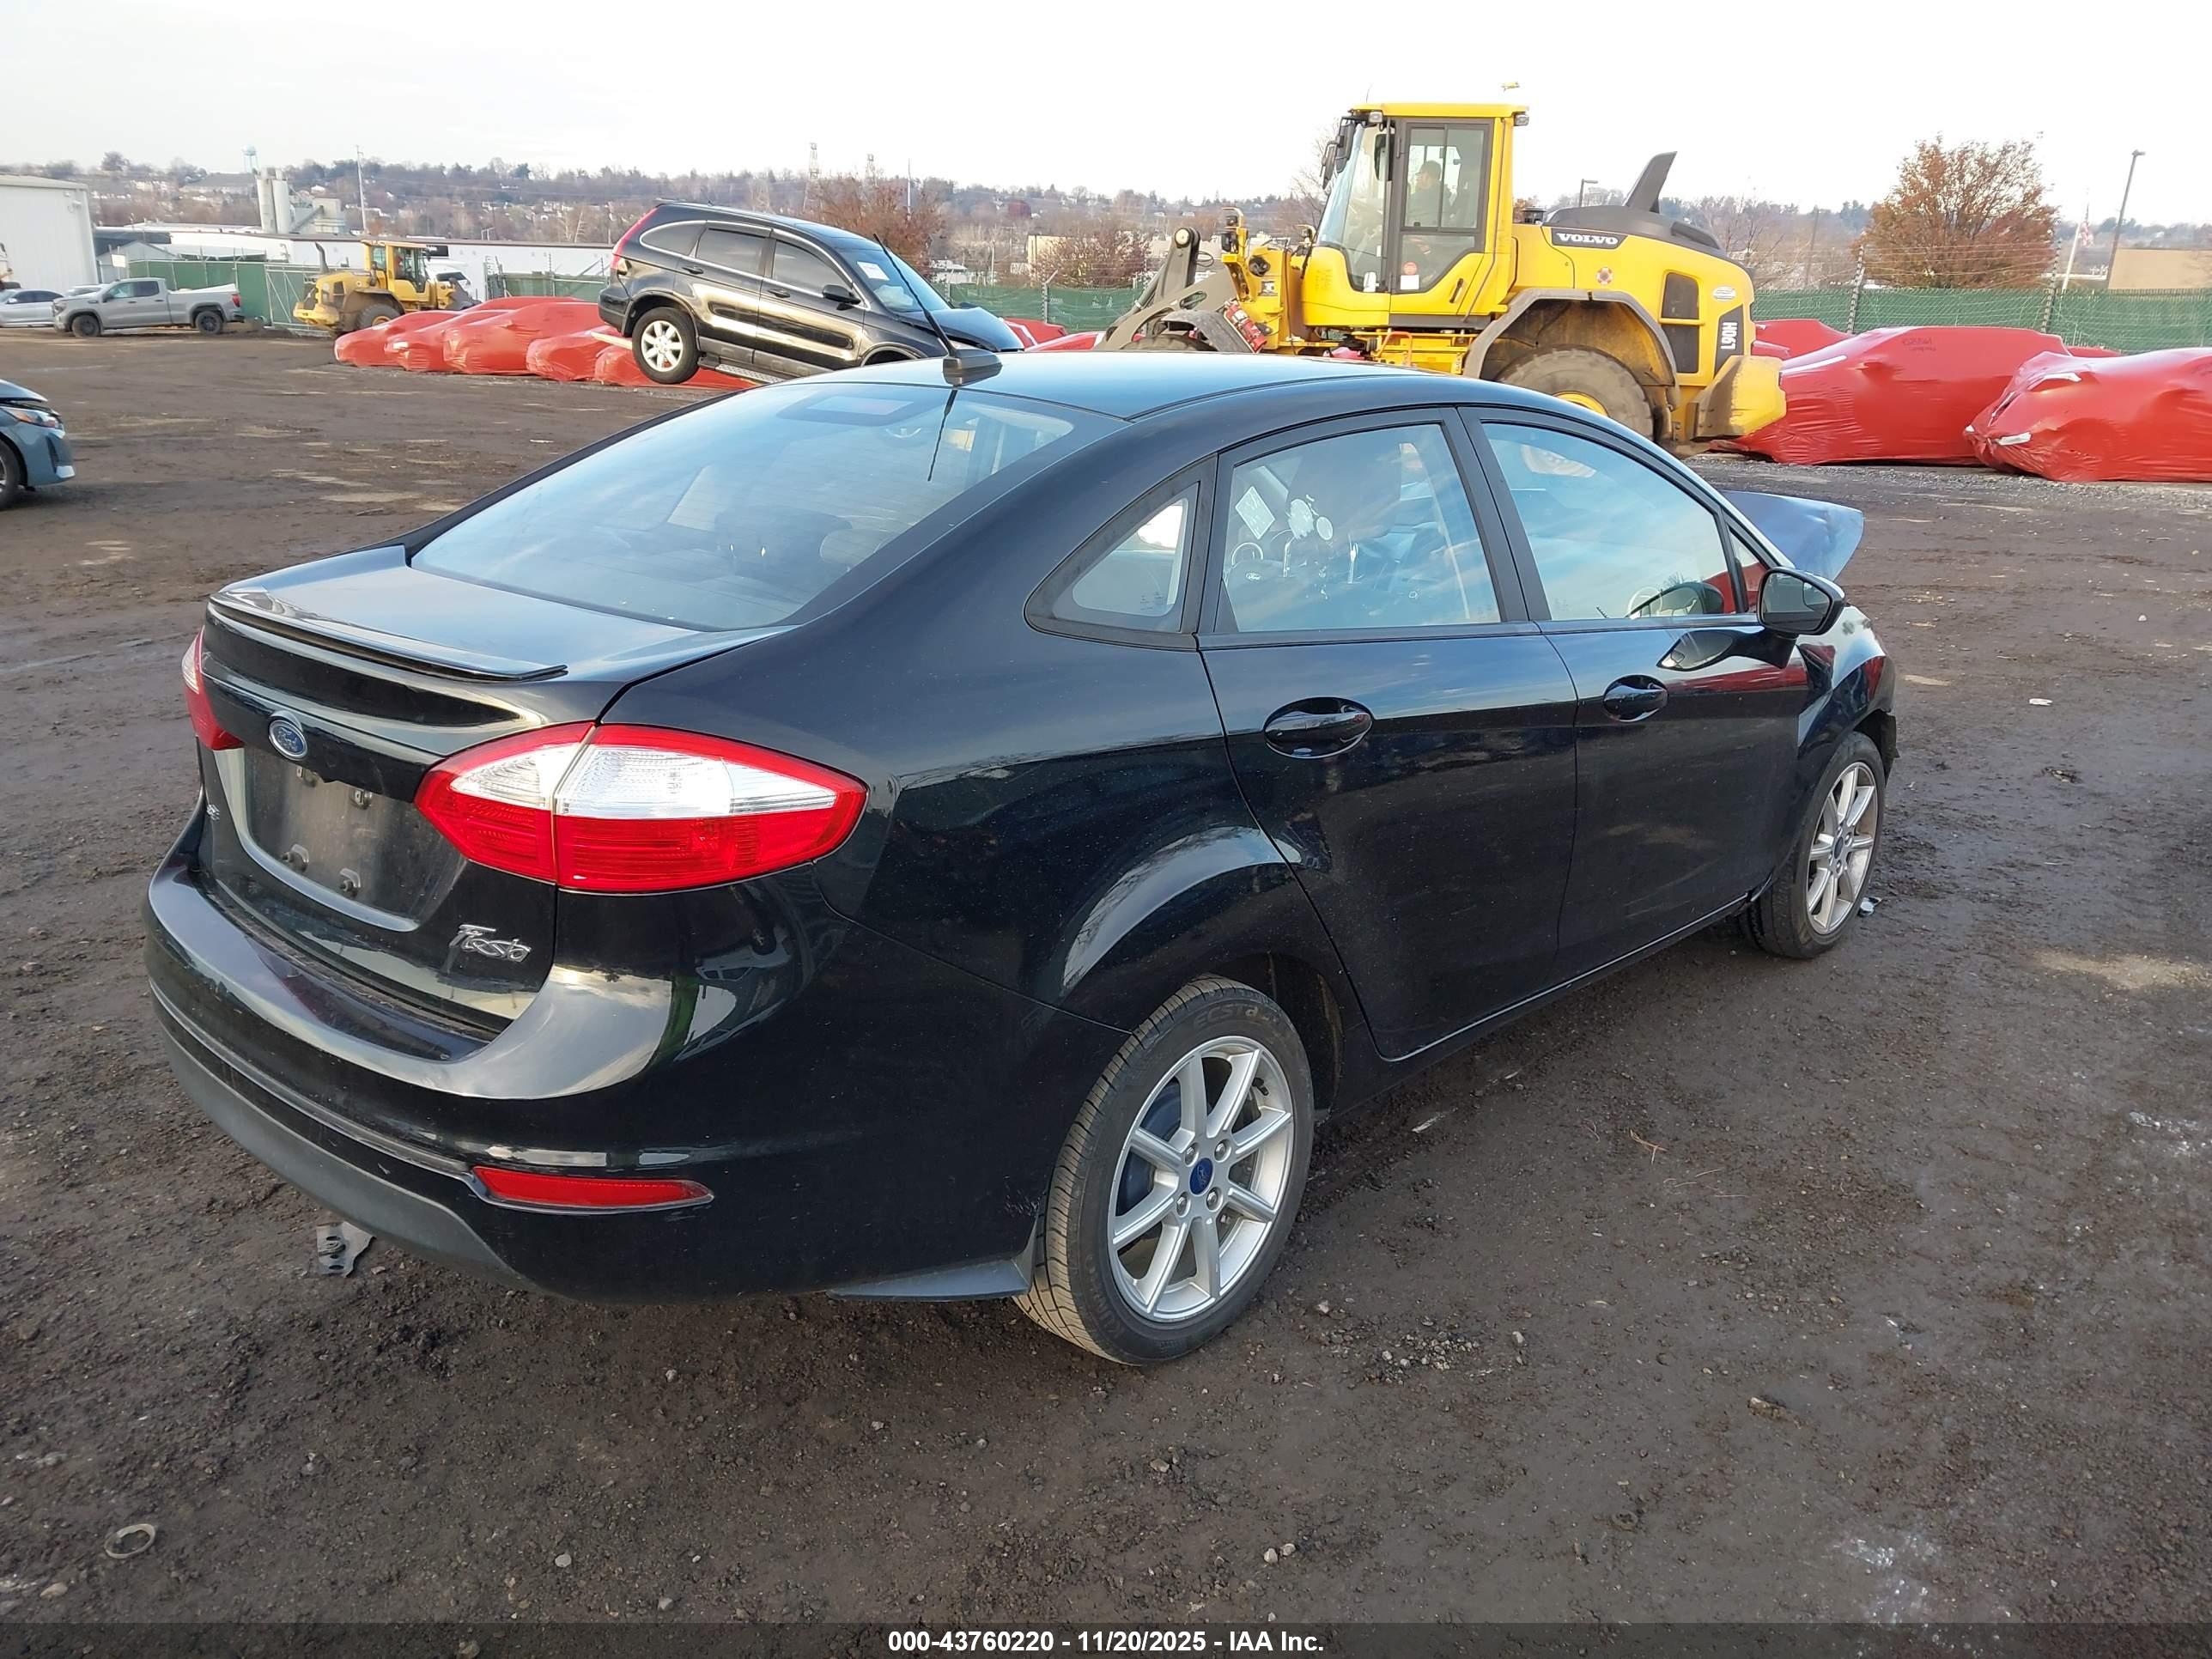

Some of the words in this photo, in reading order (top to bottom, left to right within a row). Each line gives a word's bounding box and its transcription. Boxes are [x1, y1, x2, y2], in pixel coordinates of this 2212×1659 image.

[1555, 232, 1619, 246] VOLVO
[1720, 320, 1739, 350] L90H
[449, 924, 532, 963] Fiesta
